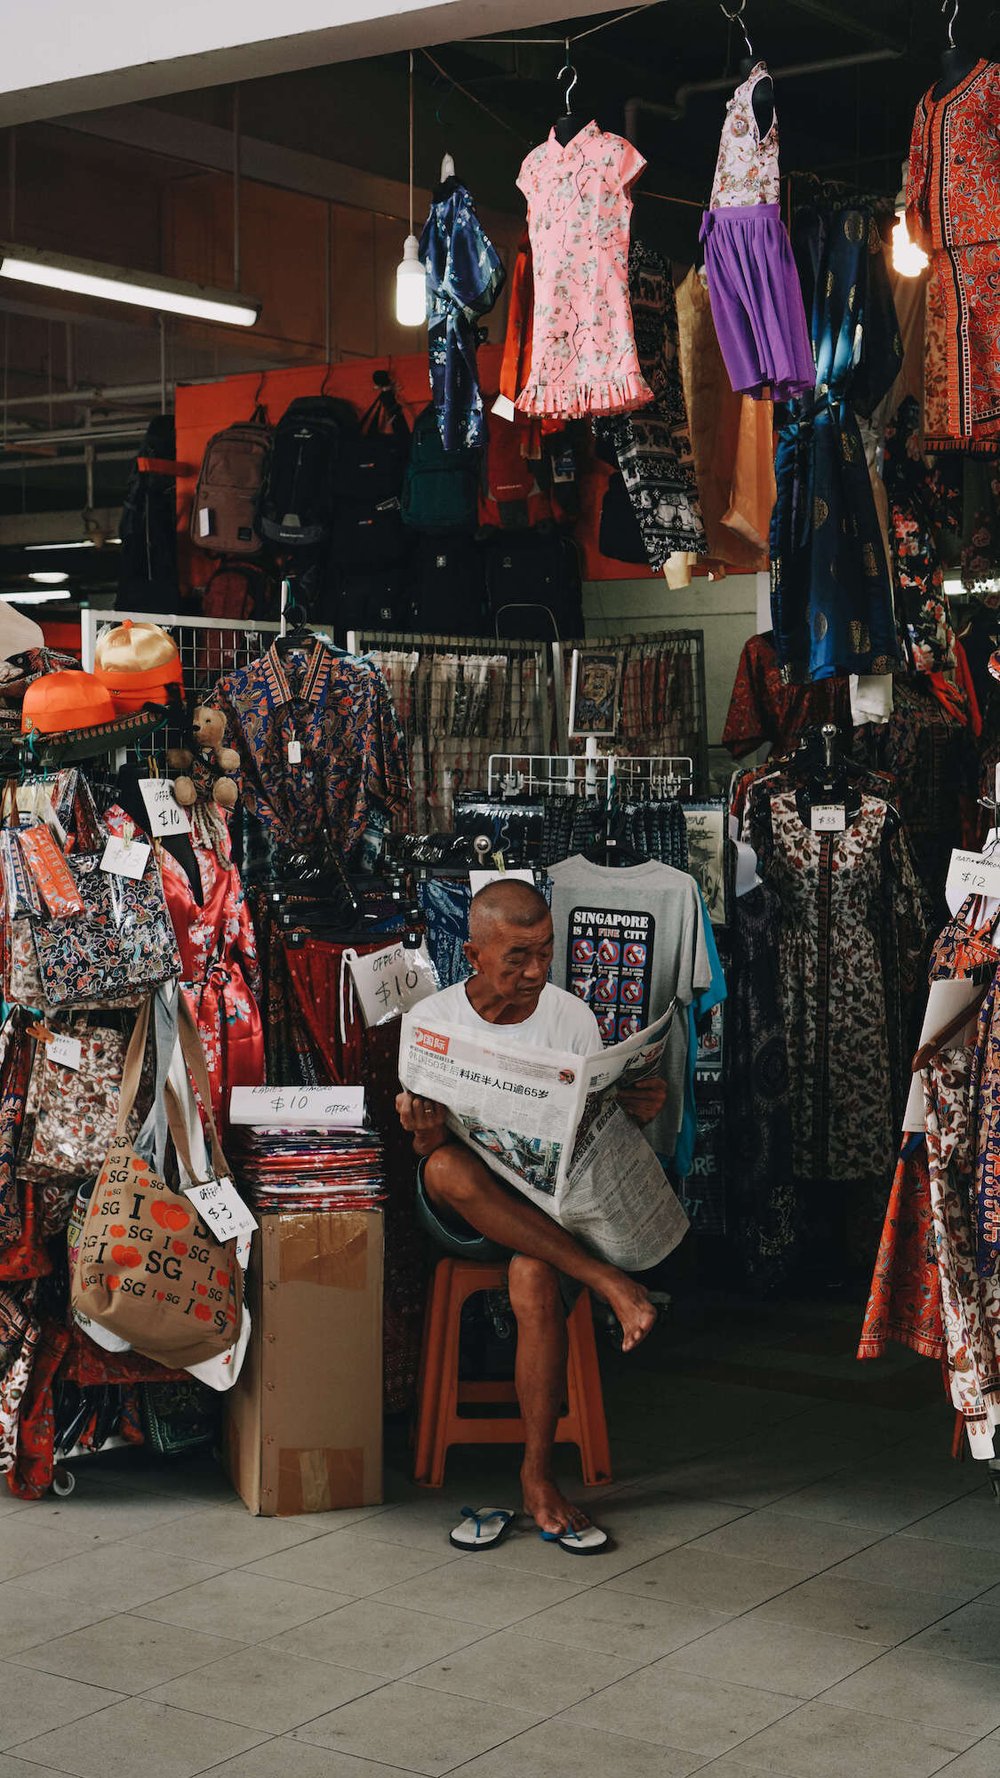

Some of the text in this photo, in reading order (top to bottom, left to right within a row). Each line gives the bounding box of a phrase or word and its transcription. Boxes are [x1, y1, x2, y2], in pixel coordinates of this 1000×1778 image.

[158, 809, 180, 827] $10
[961, 872, 986, 888] $12
[573, 911, 649, 929] SINGAPORE
[572, 926, 582, 936] IS
[586, 927, 593, 937] A
[623, 929, 648, 940] CITY
[372, 948, 403, 973] OFFER
[374, 969, 418, 1007] $10
[270, 1096, 308, 1112] $10
[112, 1136, 128, 1149] SG
[109, 1156, 120, 1165] SG
[122, 1156, 131, 1168] I
[108, 1170, 129, 1183] SG
[133, 1175, 165, 1191] I SG
[101, 1201, 120, 1215] SG
[128, 1193, 146, 1220] I
[208, 1202, 232, 1221] $3
[101, 1224, 153, 1242] I SG
[163, 1235, 210, 1264] I SG
[95, 1242, 183, 1281] I SG
[208, 1265, 216, 1281] I
[120, 1278, 147, 1297] SG
[191, 1280, 223, 1302] I SG
[151, 1289, 181, 1305] I SG
[184, 1298, 195, 1315] I
